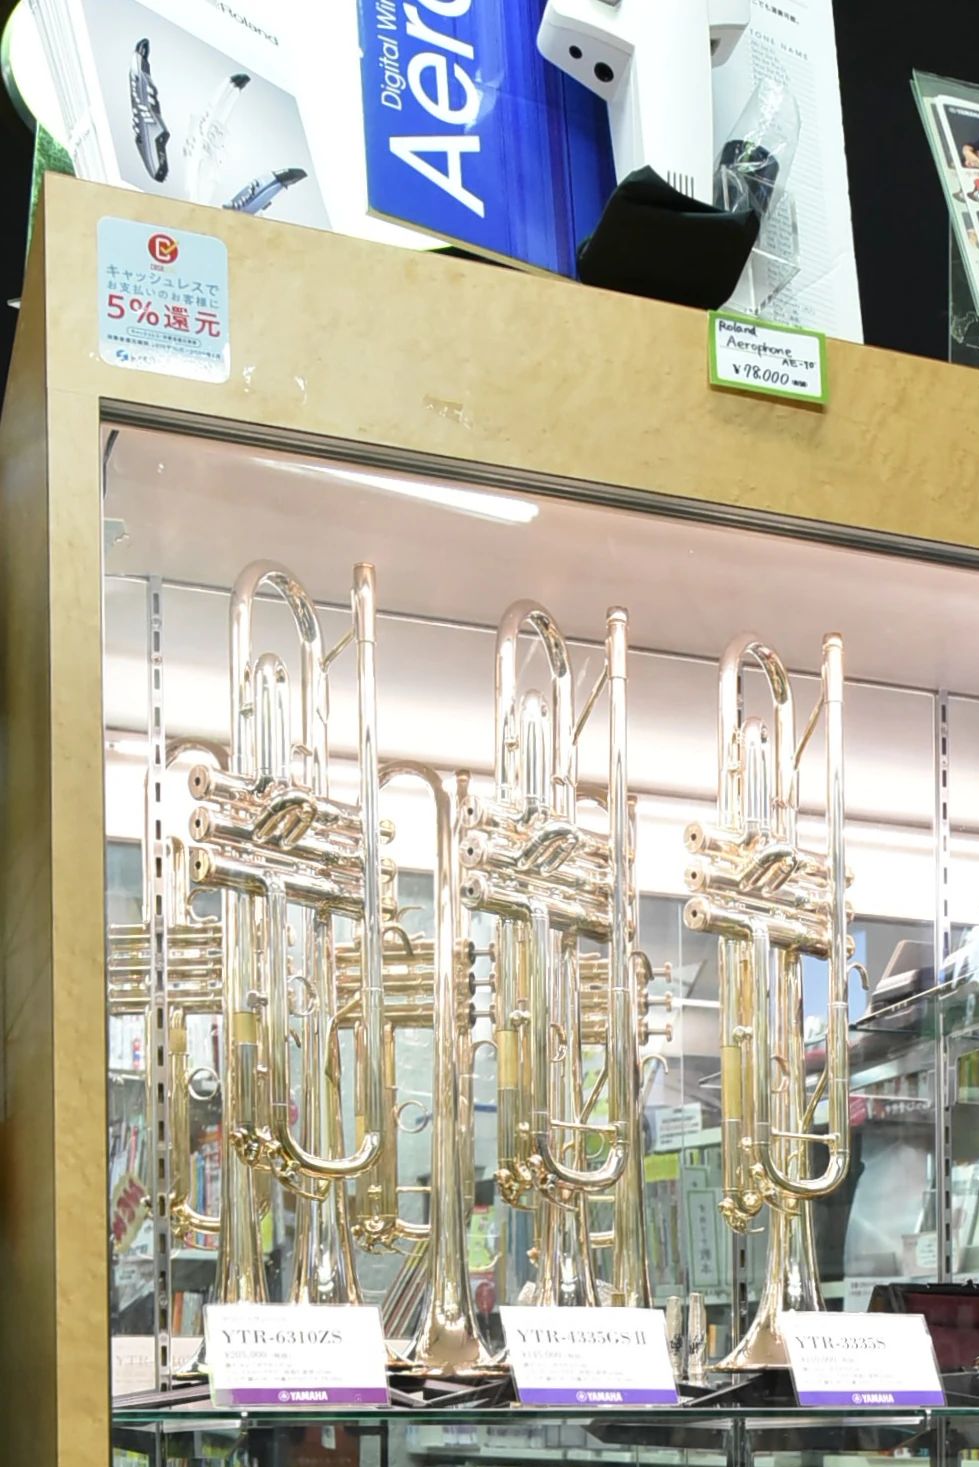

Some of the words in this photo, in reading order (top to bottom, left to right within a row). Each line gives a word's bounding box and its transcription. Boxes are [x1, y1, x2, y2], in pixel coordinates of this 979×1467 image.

[375, 33, 407, 111] Digital
[388, 0, 485, 219] Aer
[106, 265, 220, 297] キャッシュレスで
[107, 280, 220, 309] お支払いのお客様に
[106, 293, 221, 338] 5%還元
[719, 320, 757, 337] Roland
[726, 335, 793, 358] Aerophone
[222, 1329, 343, 1345] YTR-6310ZS
[795, 1335, 887, 1350] YTR-3335S
[290, 1391, 329, 1401] YAMAHA
[586, 1391, 624, 1402] YAMAHA
[861, 1393, 895, 1404] YAMAHA
